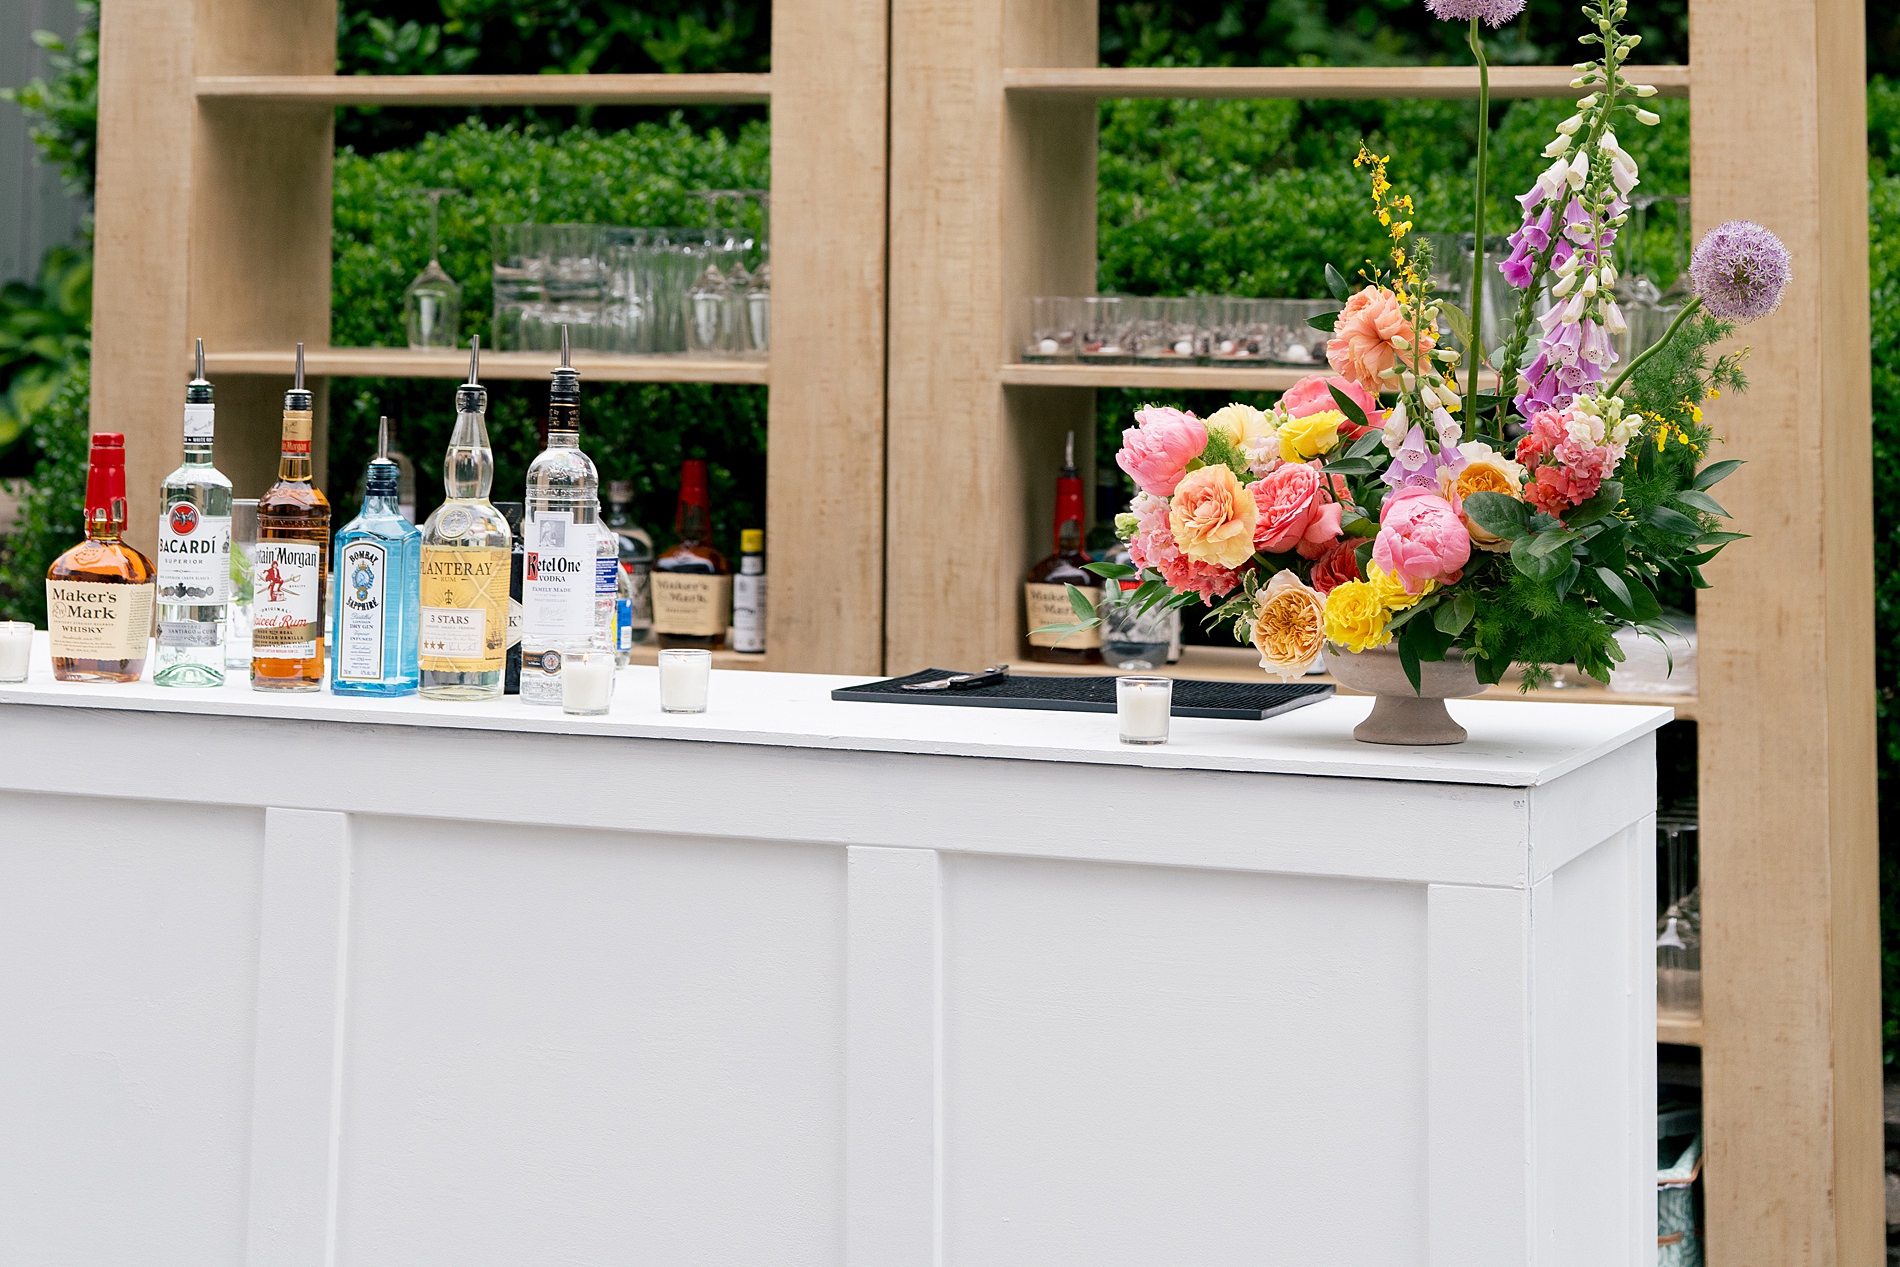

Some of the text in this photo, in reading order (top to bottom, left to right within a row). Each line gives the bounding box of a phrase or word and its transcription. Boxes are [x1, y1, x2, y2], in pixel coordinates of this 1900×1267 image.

[275, 547, 317, 568] Morgan
[349, 550, 379, 566] BOMBAY
[527, 554, 556, 579] Ketel
[557, 556, 581, 573] One
[539, 575, 566, 583] VODKA
[52, 587, 117, 604] Maker's
[346, 596, 379, 611] SAPPHIRE
[67, 605, 116, 620] Mark
[430, 614, 470, 625] 3 STARS
[279, 614, 308, 629] Rum
[61, 625, 104, 634] WHISKY
